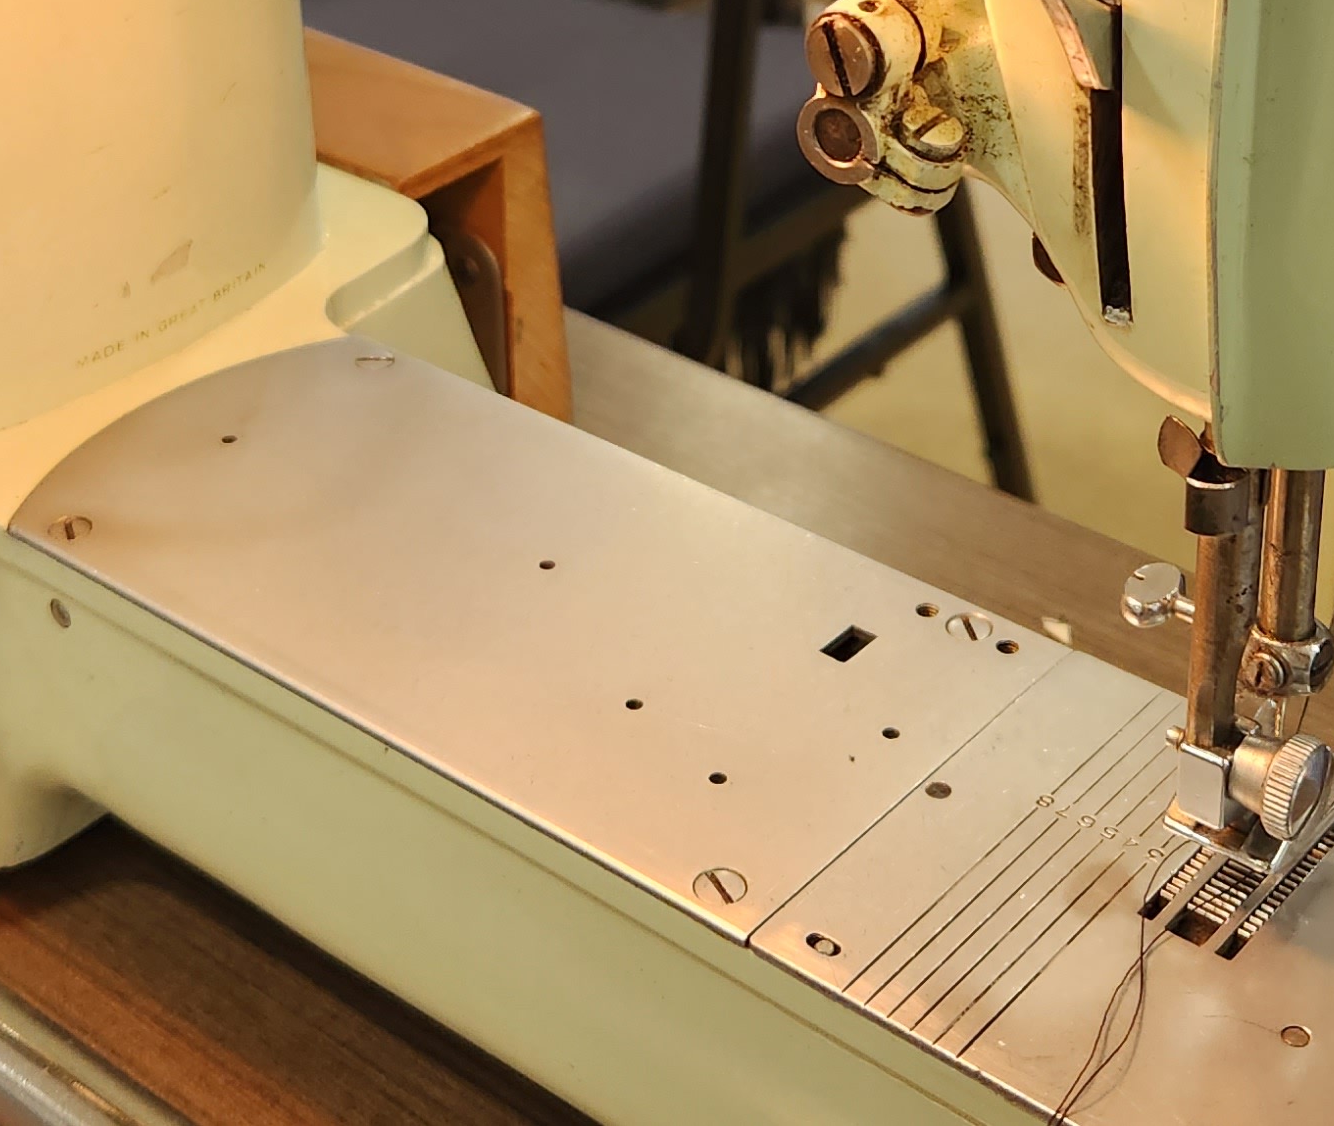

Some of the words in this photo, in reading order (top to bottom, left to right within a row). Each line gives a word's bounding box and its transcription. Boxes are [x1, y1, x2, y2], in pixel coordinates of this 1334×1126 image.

[75, 340, 126, 370] MADE
[133, 327, 150, 343] IN
[157, 298, 207, 333] GREAT
[212, 261, 267, 303] BRITAIN
[1036, 794, 1055, 808] 8
[1055, 804, 1071, 819] 7
[1076, 814, 1096, 829] 6
[1099, 826, 1119, 840] 5
[1144, 847, 1165, 863] 3
